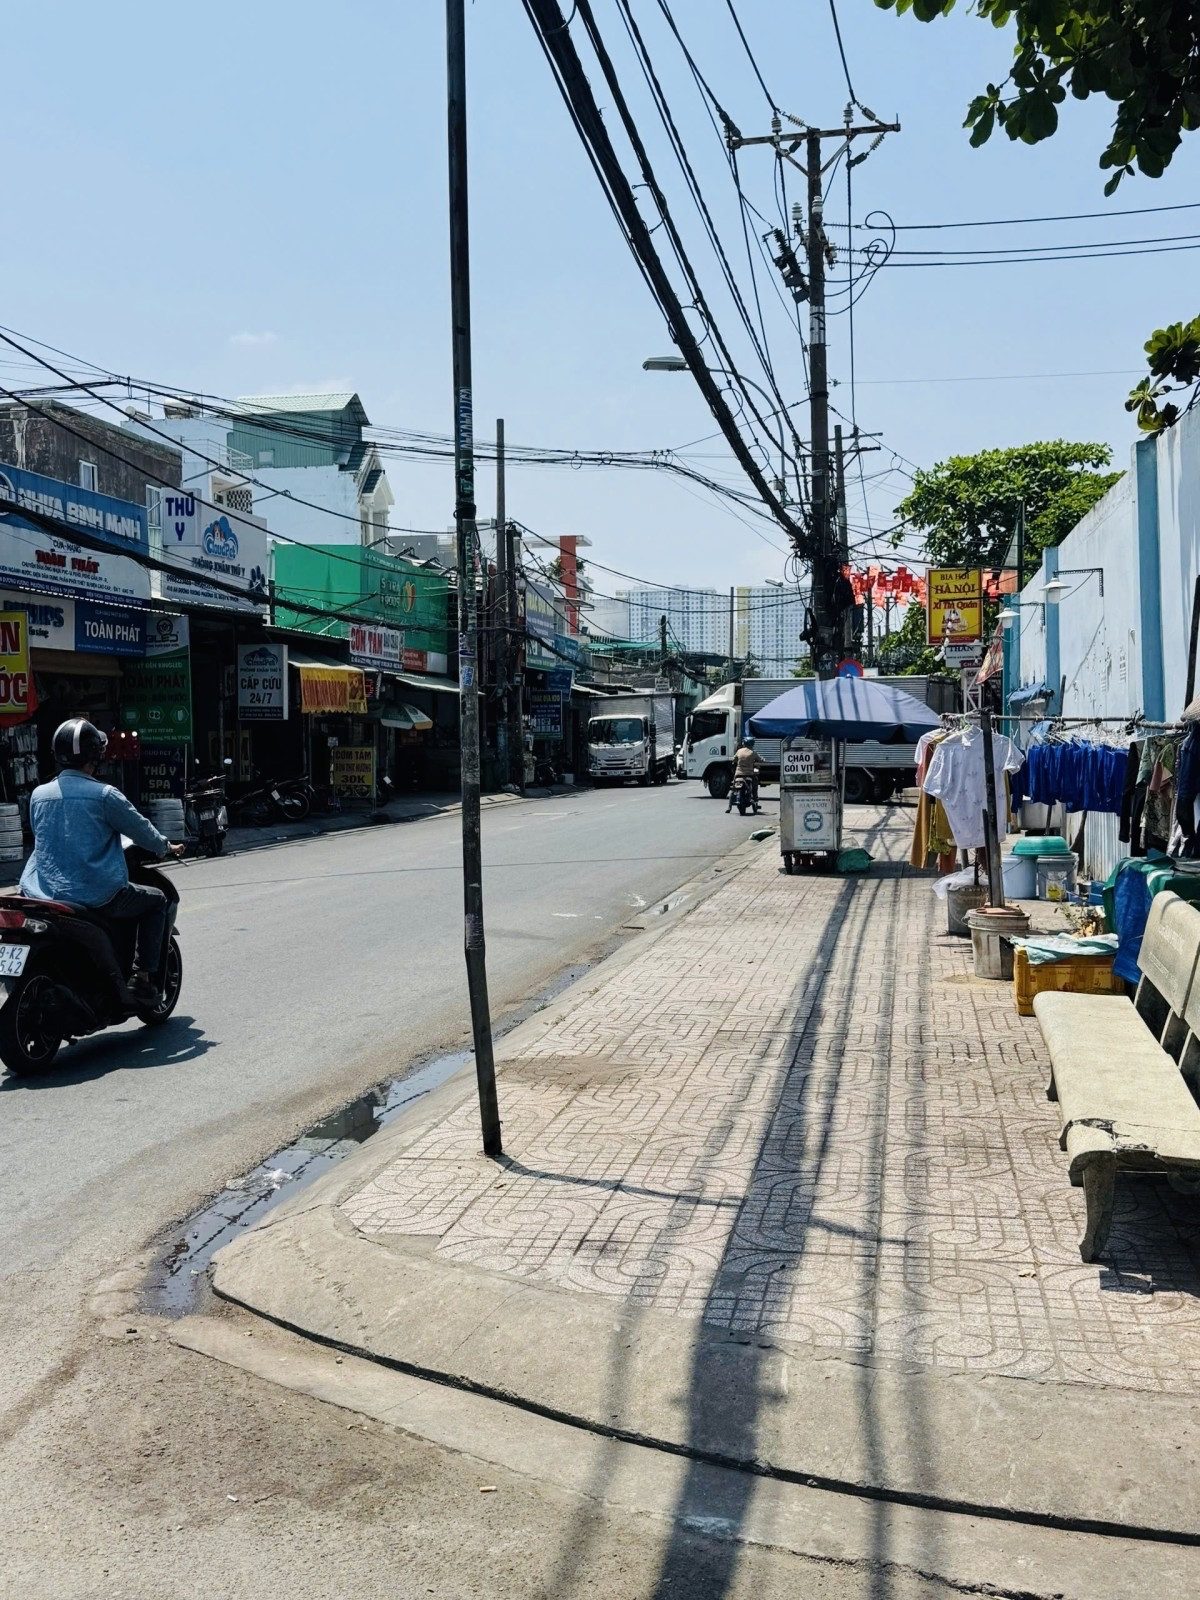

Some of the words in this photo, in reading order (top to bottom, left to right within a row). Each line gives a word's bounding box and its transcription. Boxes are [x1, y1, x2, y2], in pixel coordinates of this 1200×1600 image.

[175, 522, 185, 541] Y
[934, 583, 951, 594] HÀ
[954, 582, 976, 595] NỘI
[84, 619, 114, 640] TOÀN
[115, 624, 141, 643] PHÁT
[240, 674, 260, 690] CẤP
[262, 676, 282, 690] CỨU
[249, 692, 273, 704] 24/7
[787, 753, 811, 763] CHÁO
[169, 766, 177, 776] Y
[801, 764, 815, 774] VỊT
[148, 779, 171, 789] SPA
[341, 774, 366, 784] 30K
